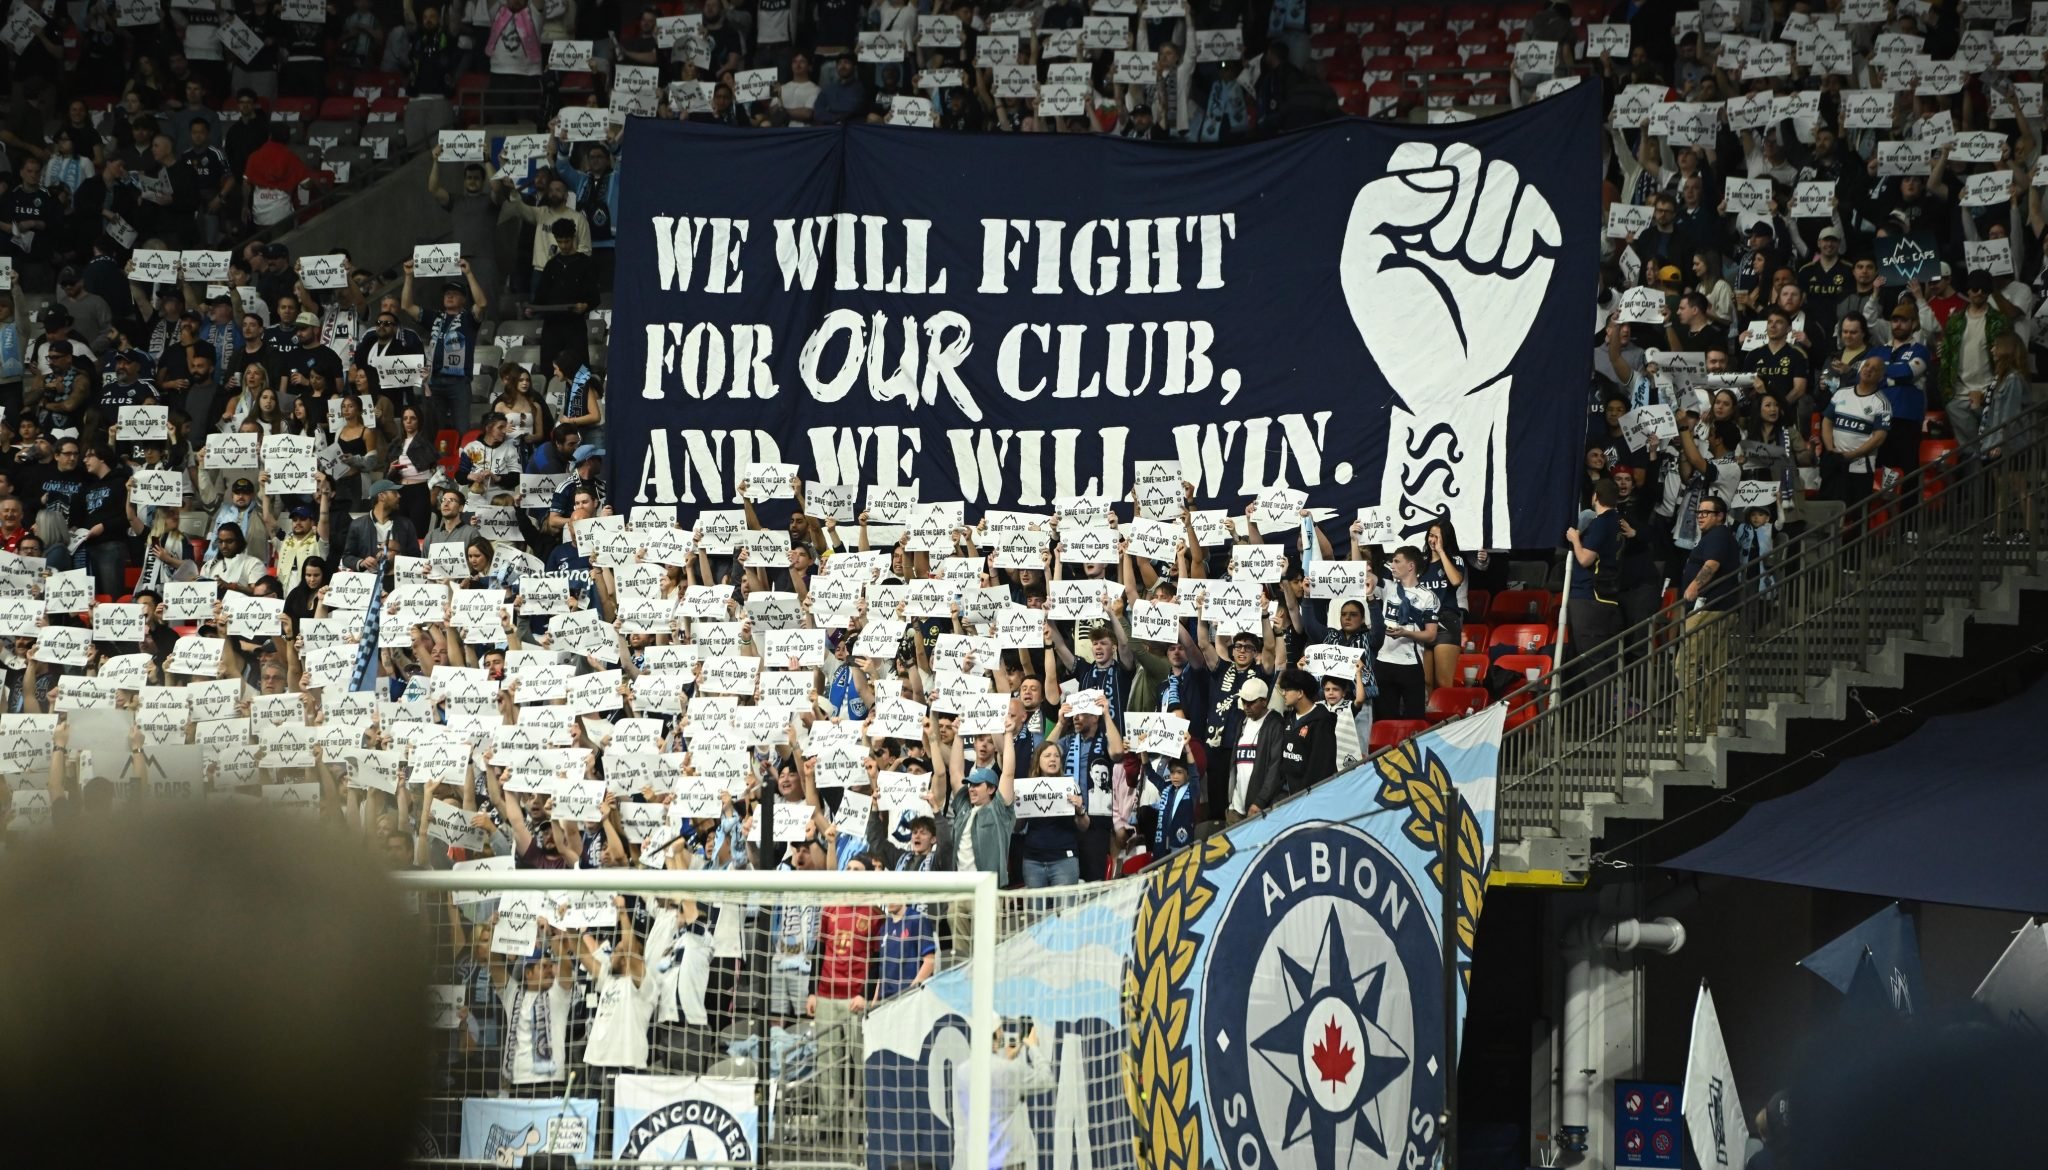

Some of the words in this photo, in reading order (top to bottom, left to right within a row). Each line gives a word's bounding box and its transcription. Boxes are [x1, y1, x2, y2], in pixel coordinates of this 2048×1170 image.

[652, 213, 749, 293] WE
[773, 213, 946, 294] WILL
[977, 213, 1235, 295] FIGHT
[1882, 255, 1907, 267] SAVE
[1912, 249, 1935, 262] CAPS
[642, 322, 779, 400] FOR
[799, 309, 983, 422] OUR
[997, 321, 1241, 405] CLUB,
[1836, 417, 1866, 431] TELUS
[634, 429, 782, 505] AND
[807, 426, 922, 502] WE
[946, 427, 1131, 504] WILL
[1172, 411, 1355, 498] WIN.
[1159, 496, 1173, 504] CAPS
[1064, 508, 1077, 516] SAVE
[625, 579, 638, 587] SAVE
[645, 577, 657, 585] CAPS
[1058, 596, 1070, 604] SAVE
[1212, 597, 1227, 605] SAVE
[1139, 615, 1150, 623] SAVE
[1157, 618, 1170, 626] CAPS
[554, 629, 566, 638] SAVE
[574, 626, 590, 634] CAPS
[260, 710, 272, 718] SAVE
[332, 708, 345, 716] SAVE
[353, 707, 366, 715] CAPS
[1022, 793, 1038, 801] SAVE
[1262, 842, 1409, 931] ALBION
[628, 1104, 745, 1160] VANCOUVER
